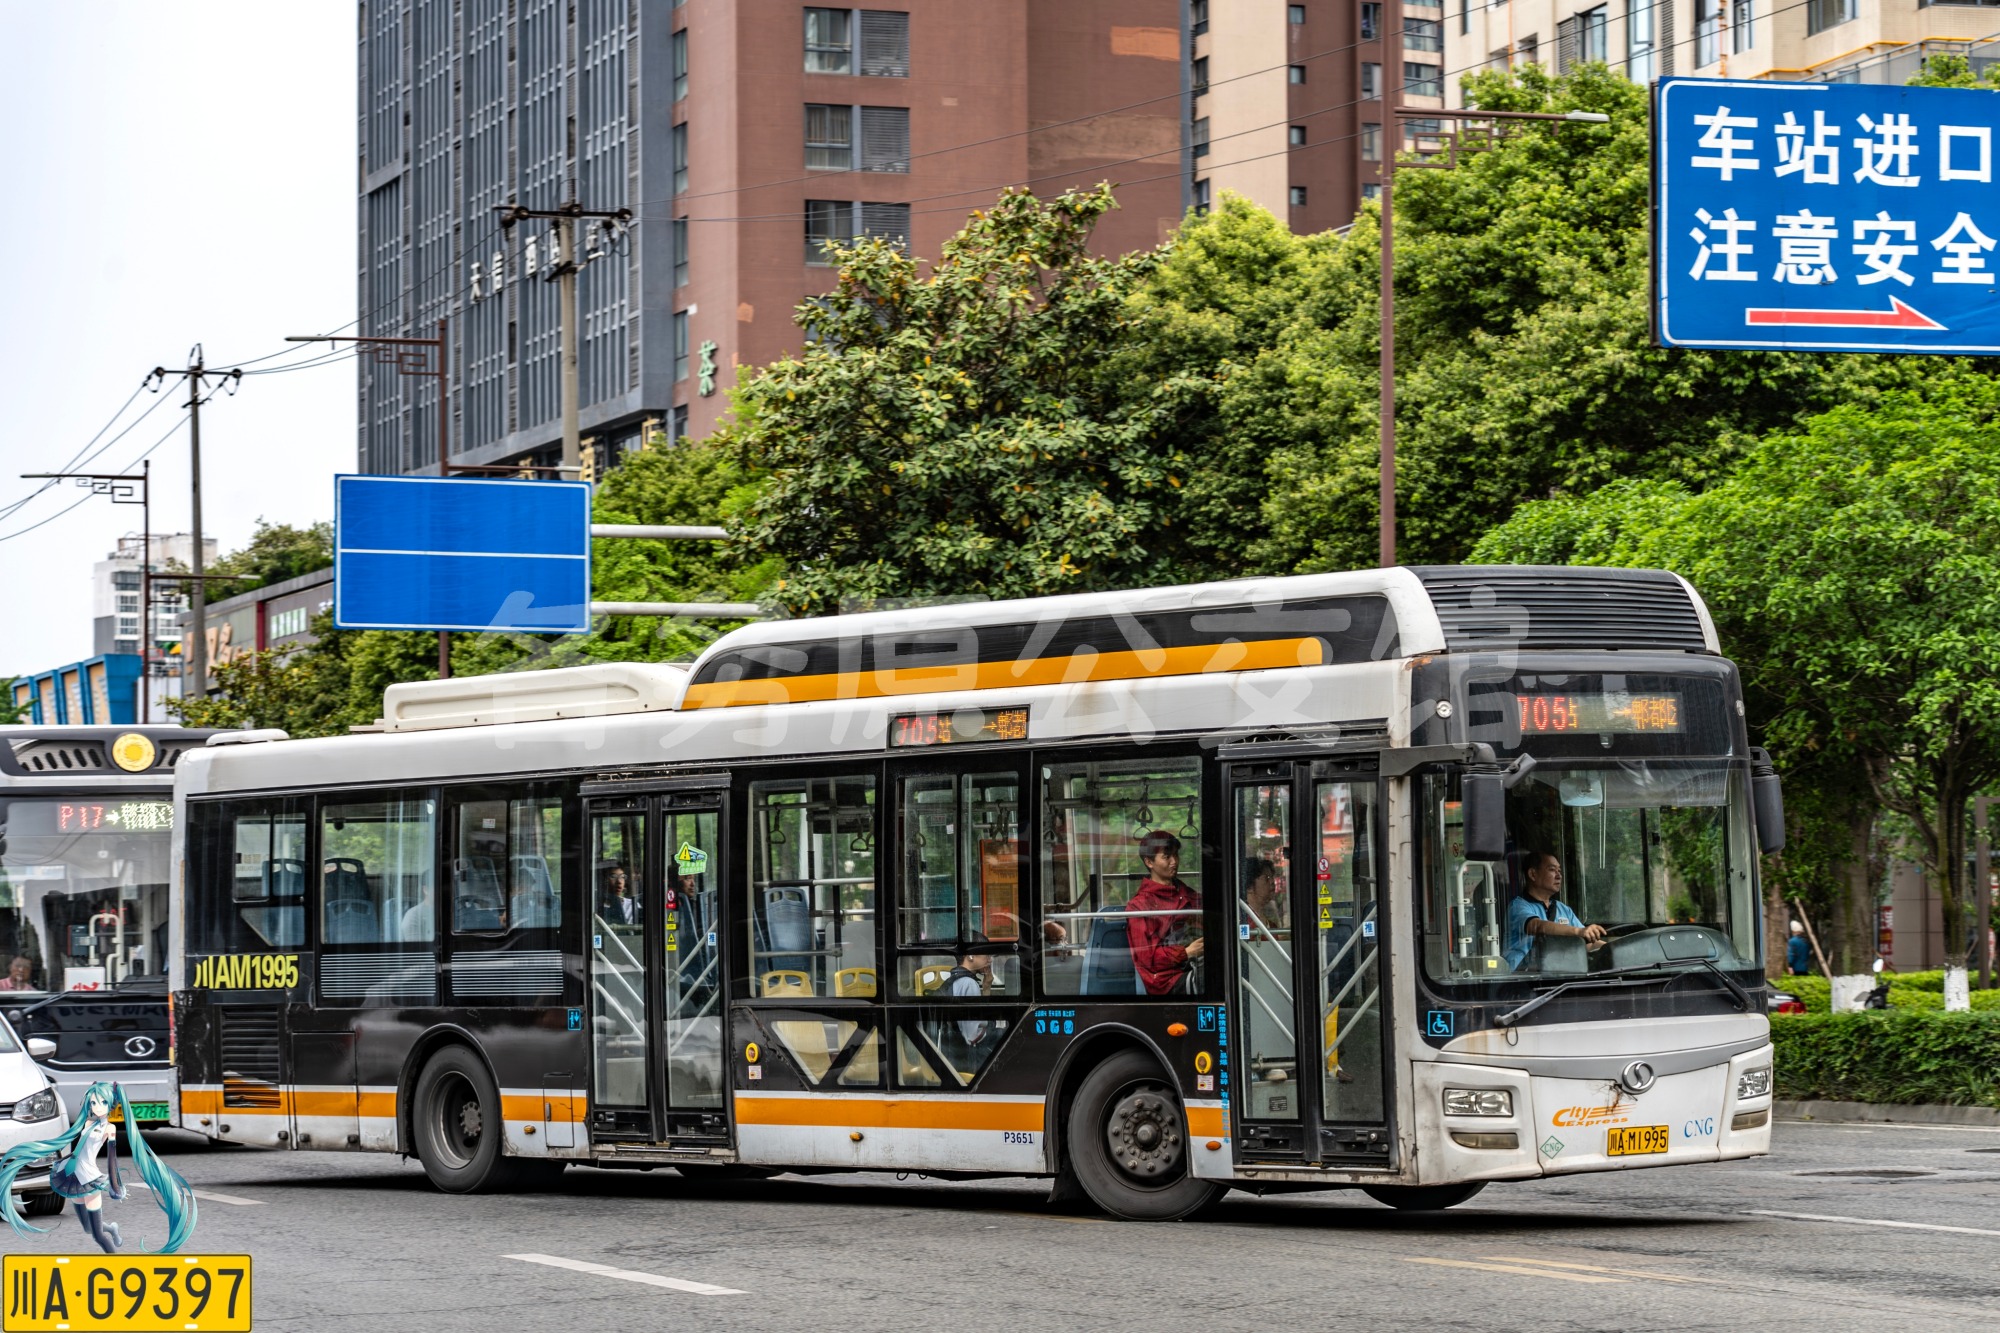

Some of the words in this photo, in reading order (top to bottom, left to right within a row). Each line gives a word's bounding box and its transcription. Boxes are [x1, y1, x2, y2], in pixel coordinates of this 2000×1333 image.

[1691, 106, 1992, 187] 车站进口
[1688, 208, 1997, 286] 注意安全
[1517, 697, 1567, 730] 705
[897, 716, 938, 746] 705
[60, 805, 104, 829] P17
[193, 955, 298, 989] 川AM1995
[1564, 1117, 1629, 1127] Express
[1684, 1117, 1714, 1138] CNG
[1004, 1132, 1033, 1144] P3651
[1544, 1142, 1560, 1152] CNG
